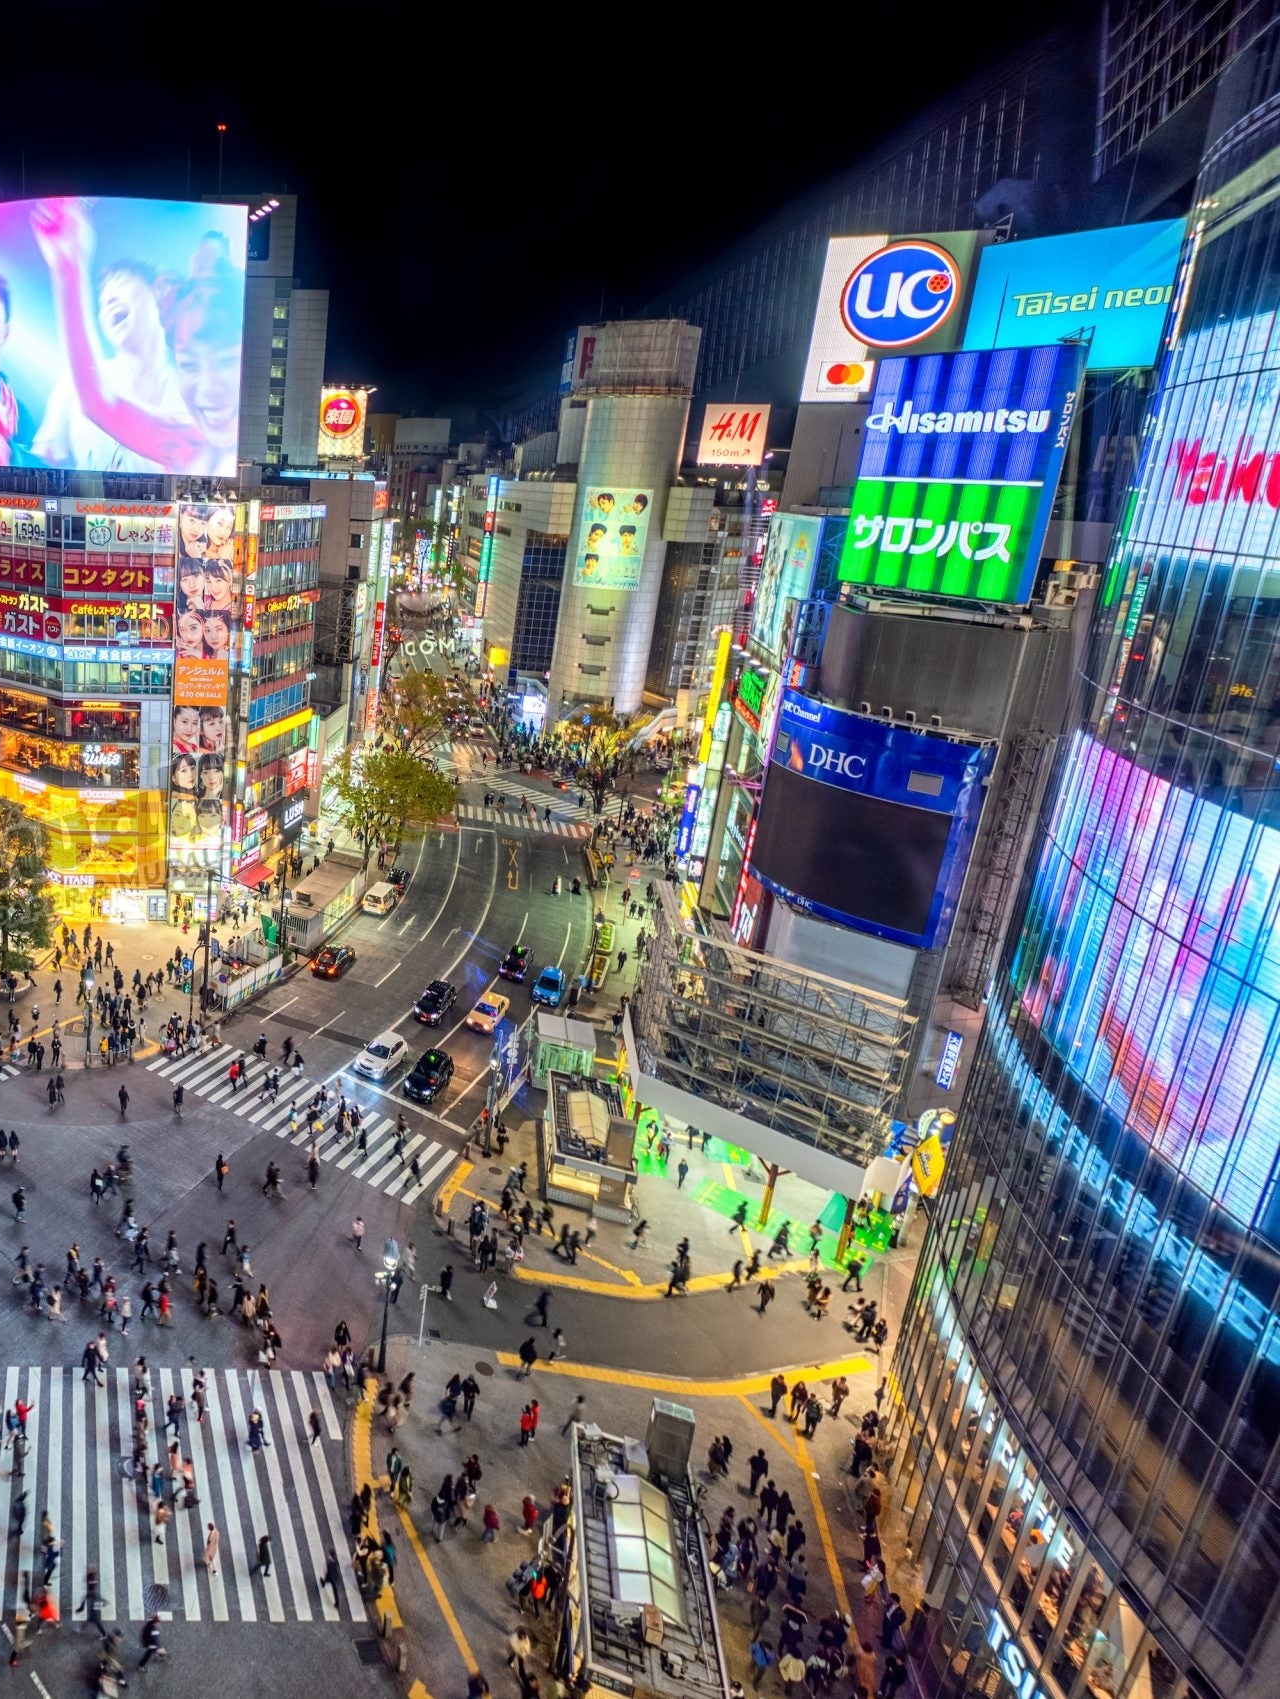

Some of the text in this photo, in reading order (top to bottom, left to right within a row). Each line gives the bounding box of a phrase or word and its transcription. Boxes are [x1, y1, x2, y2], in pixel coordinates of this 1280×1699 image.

[855, 270, 945, 320] UC
[1013, 287, 1097, 318] Taisei
[325, 408, 355, 425] 楽園
[709, 411, 762, 442] H&M
[866, 400, 1050, 434] Hisamitsu
[1054, 390, 1077, 449] サロンパス
[711, 449, 740, 457] 150m
[116, 523, 173, 544] しゃぶ葉
[853, 515, 1012, 564] サロンパス
[63, 568, 151, 588] コンタクト
[18, 593, 49, 613] ガスト
[123, 603, 164, 620] ガスト
[4, 610, 40, 636] ガスト
[98, 650, 173, 662] 英会話イーオン
[793, 705, 821, 723] Channel
[808, 743, 867, 778] DHC
[284, 801, 304, 824] LUSH
[796, 896, 813, 910] DHC
